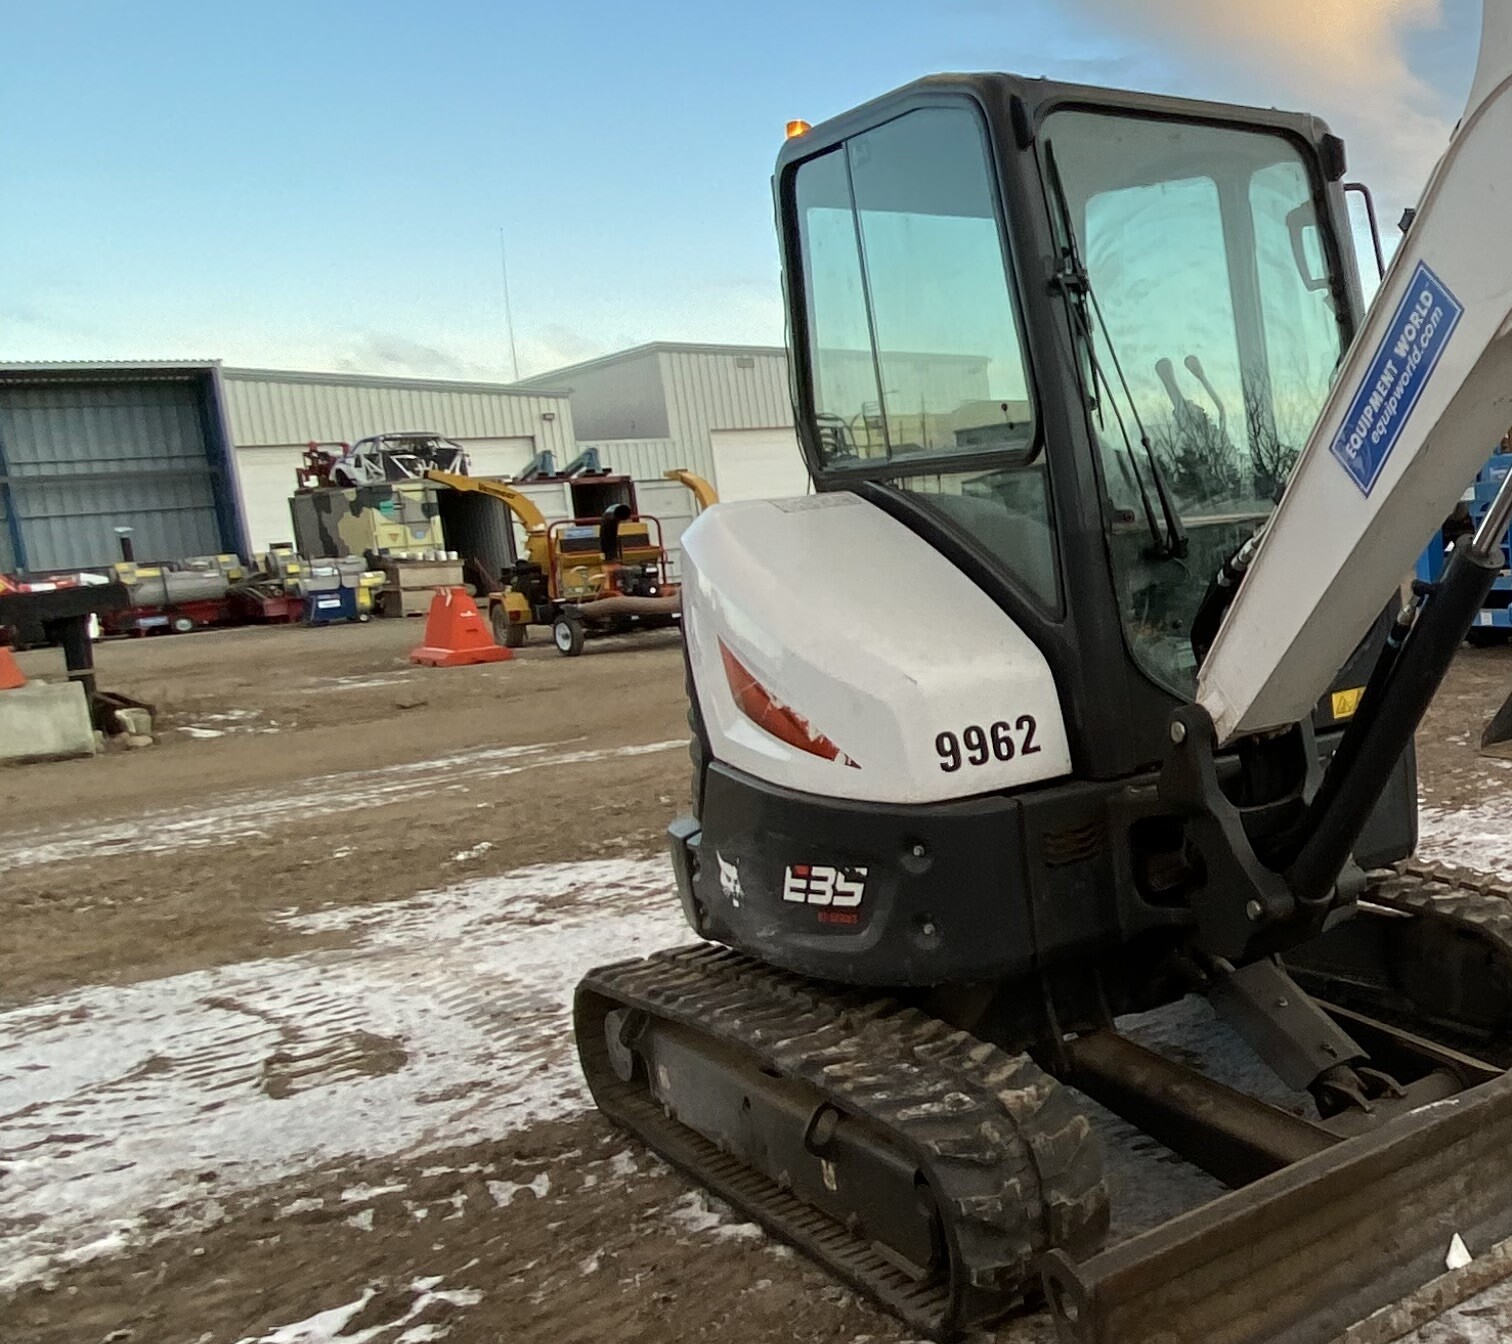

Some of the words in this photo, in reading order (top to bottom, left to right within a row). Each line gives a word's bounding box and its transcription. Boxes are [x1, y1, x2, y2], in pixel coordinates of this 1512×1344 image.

[1345, 359, 1399, 459] EQUIPMENT
[1394, 290, 1434, 360] WORLD
[1371, 306, 1444, 444] equipworld.com
[935, 714, 1042, 773] 9962
[783, 864, 868, 907] E35
